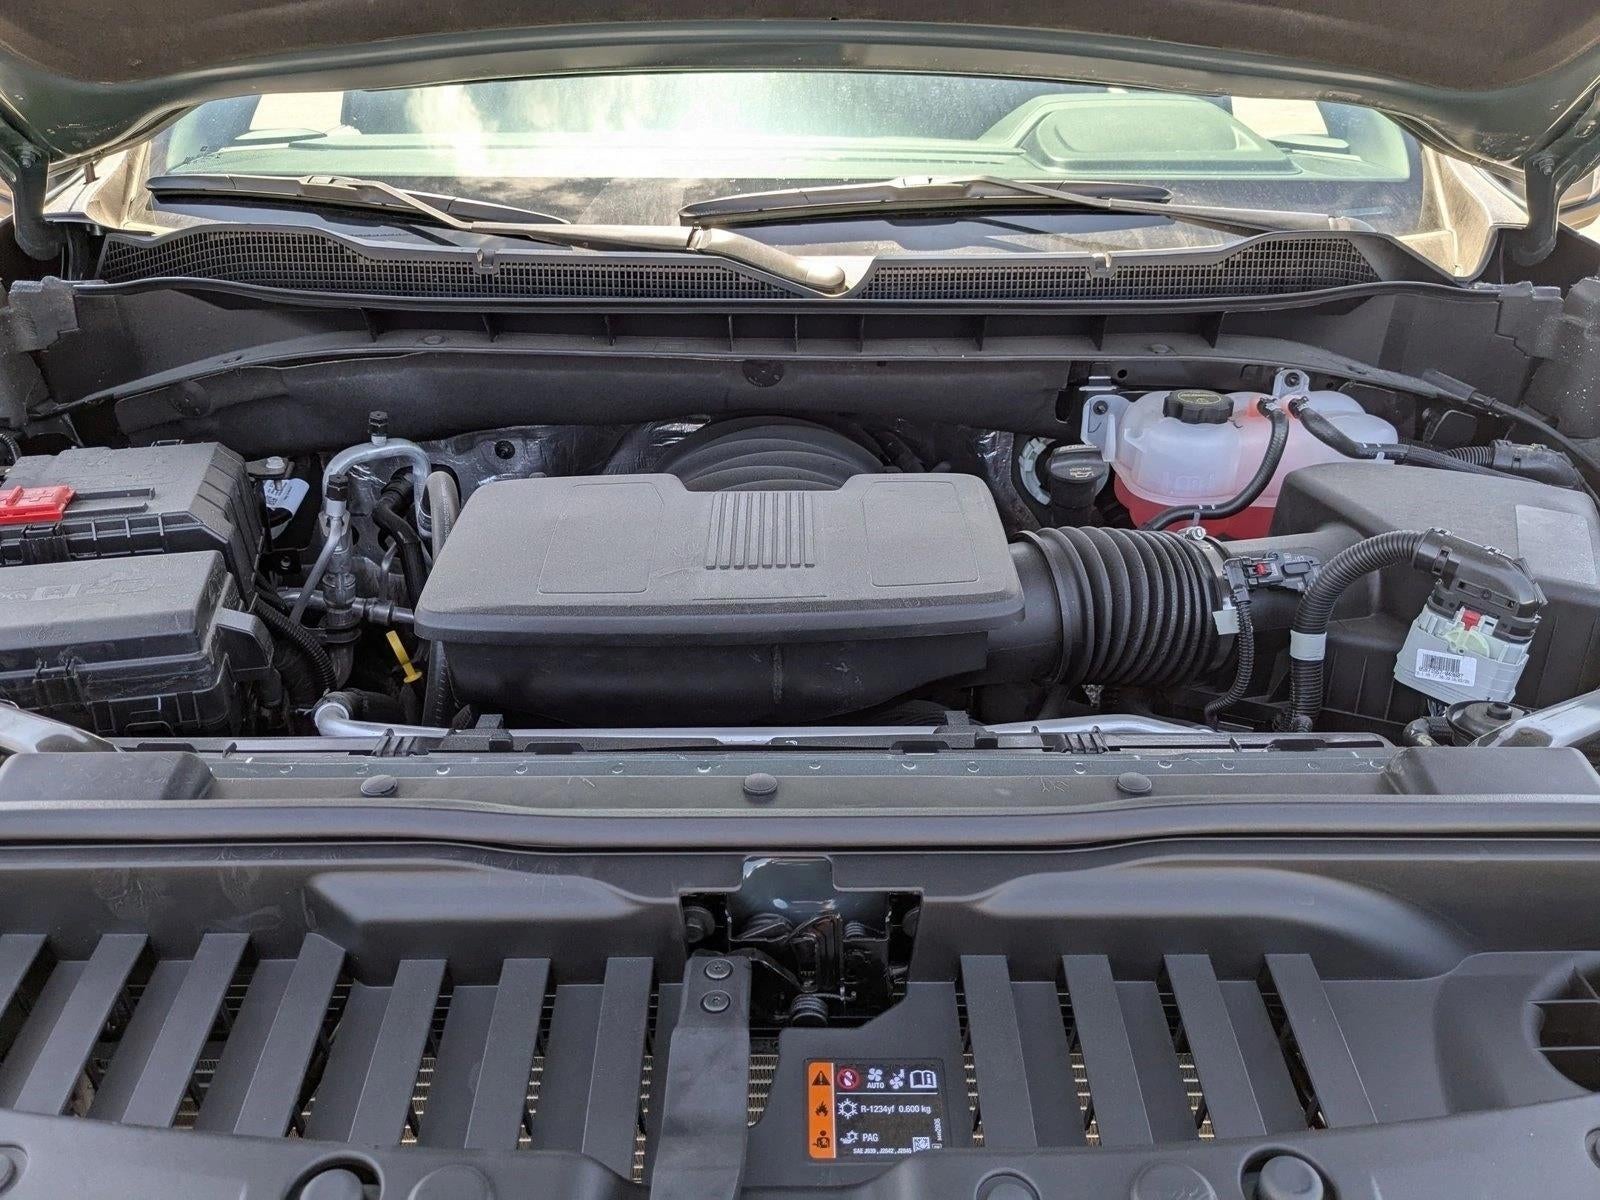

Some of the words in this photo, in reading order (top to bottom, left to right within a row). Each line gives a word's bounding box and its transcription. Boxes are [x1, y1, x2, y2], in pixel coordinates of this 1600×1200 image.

[860, 1105, 895, 1115] R-1234yf
[898, 1105, 920, 1113] 0.600
[921, 1105, 931, 1115] kg
[862, 1133, 879, 1142] PAG
